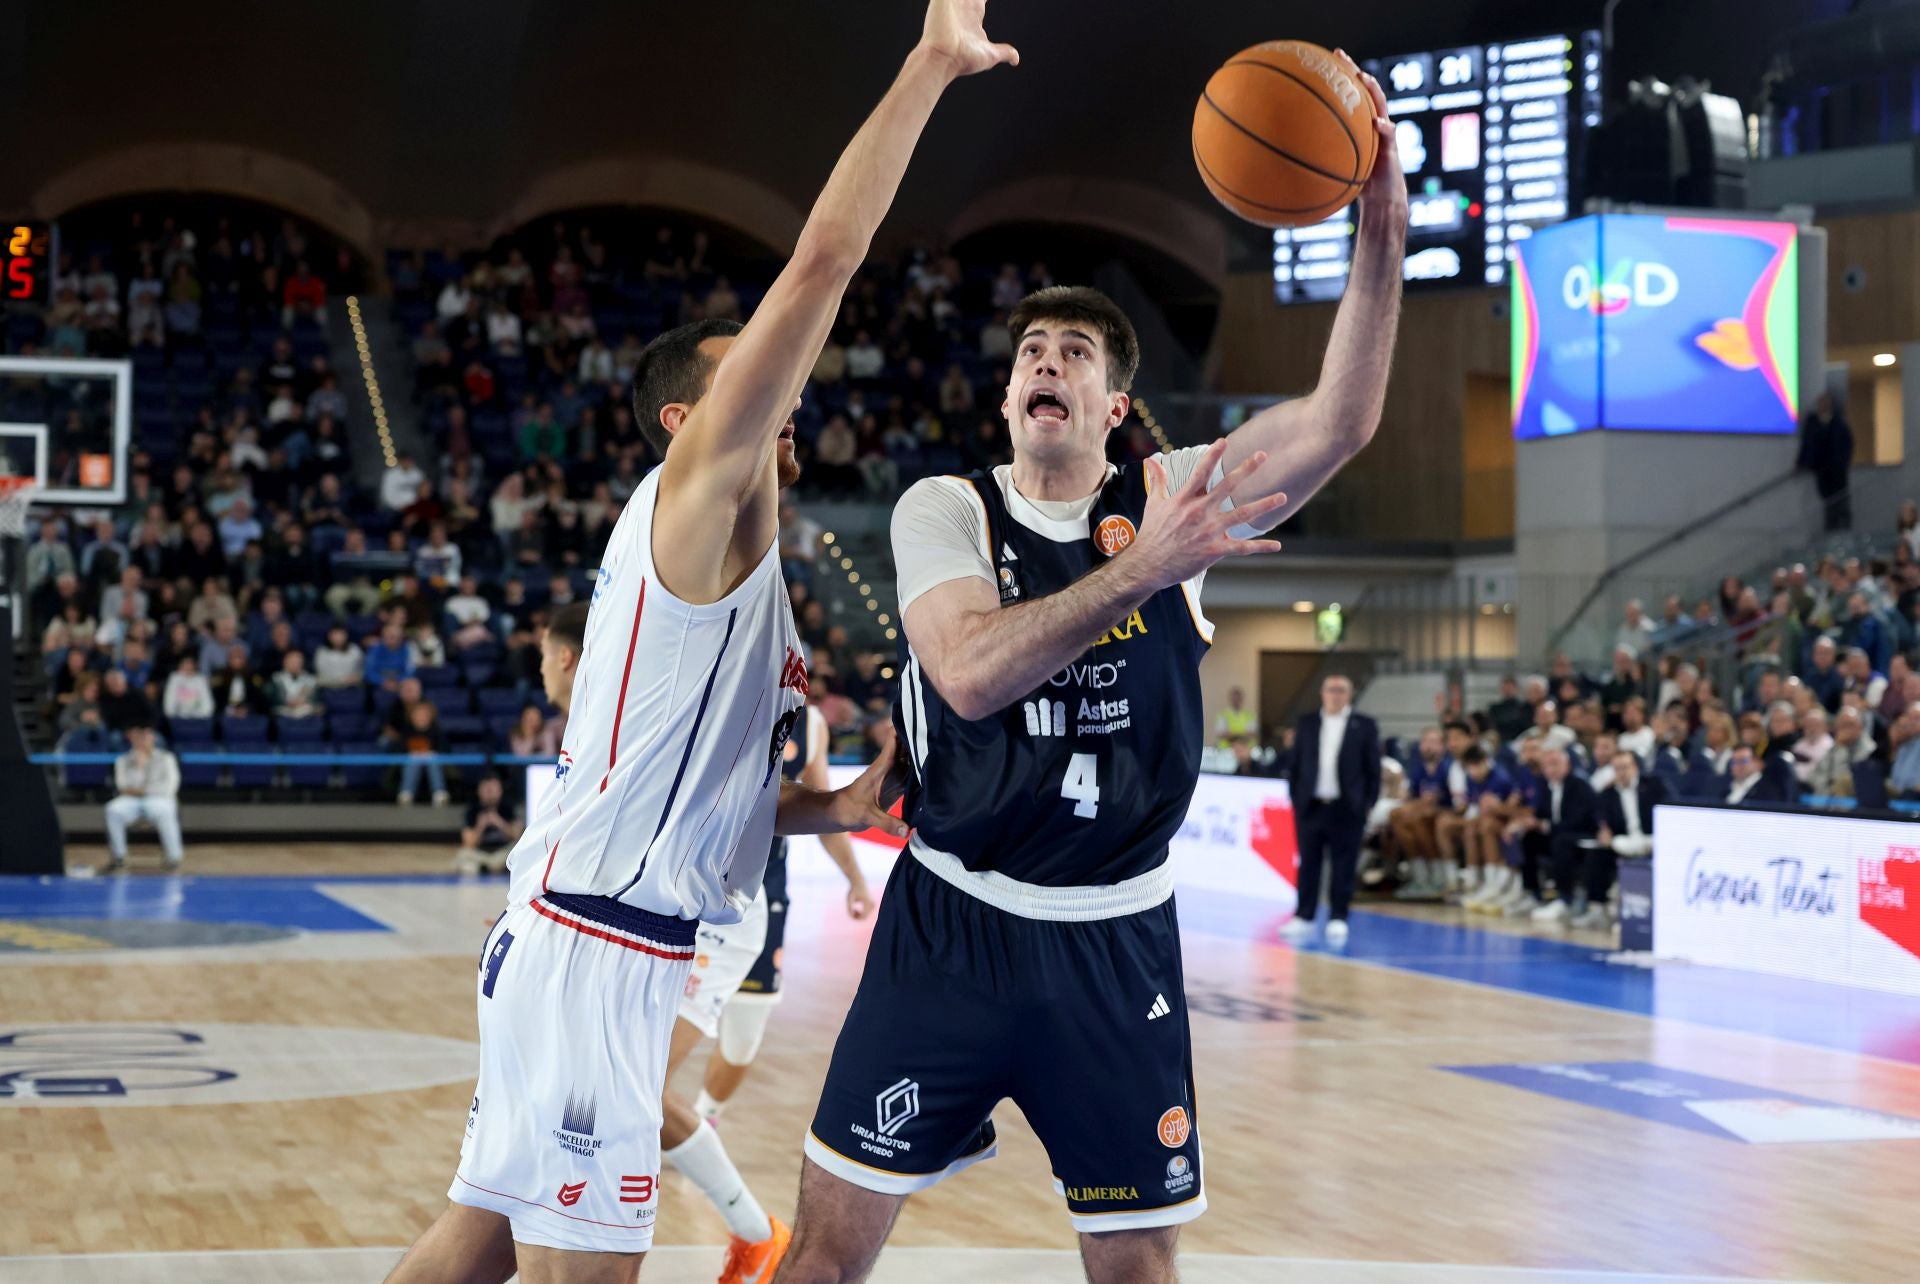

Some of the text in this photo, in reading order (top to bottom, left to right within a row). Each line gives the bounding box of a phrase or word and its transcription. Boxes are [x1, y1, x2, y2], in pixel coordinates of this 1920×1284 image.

[1060, 752, 1100, 819] 4
[552, 1129, 590, 1147] CONCELLO
[851, 1123, 911, 1152] URIA MOTOR
[559, 1140, 595, 1158] SANTIAGO
[860, 1141, 894, 1158] OVIEDO
[1164, 1172, 1194, 1189] OVIEDO
[1066, 1186, 1139, 1201] ALIMERKA
